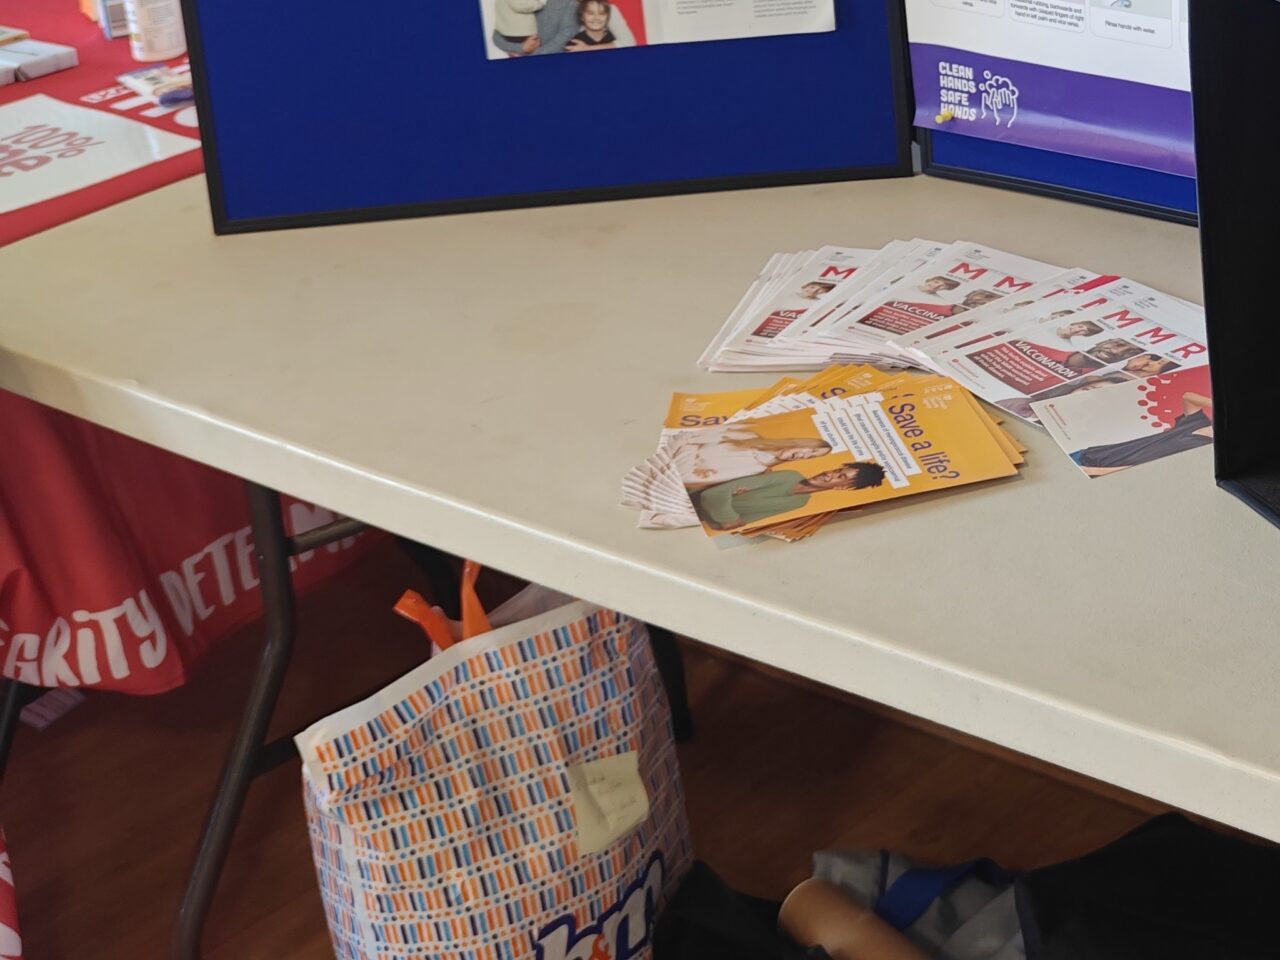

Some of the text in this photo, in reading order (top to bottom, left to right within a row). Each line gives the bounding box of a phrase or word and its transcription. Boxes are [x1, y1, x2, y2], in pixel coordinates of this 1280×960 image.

[939, 62, 974, 80] CLEAN
[940, 75, 976, 93] HANDS
[940, 89, 969, 106] SAFE
[1102, 309, 1206, 358] M M R
[1014, 340, 1078, 378] VACCINATION
[888, 404, 960, 480] Save a life?
